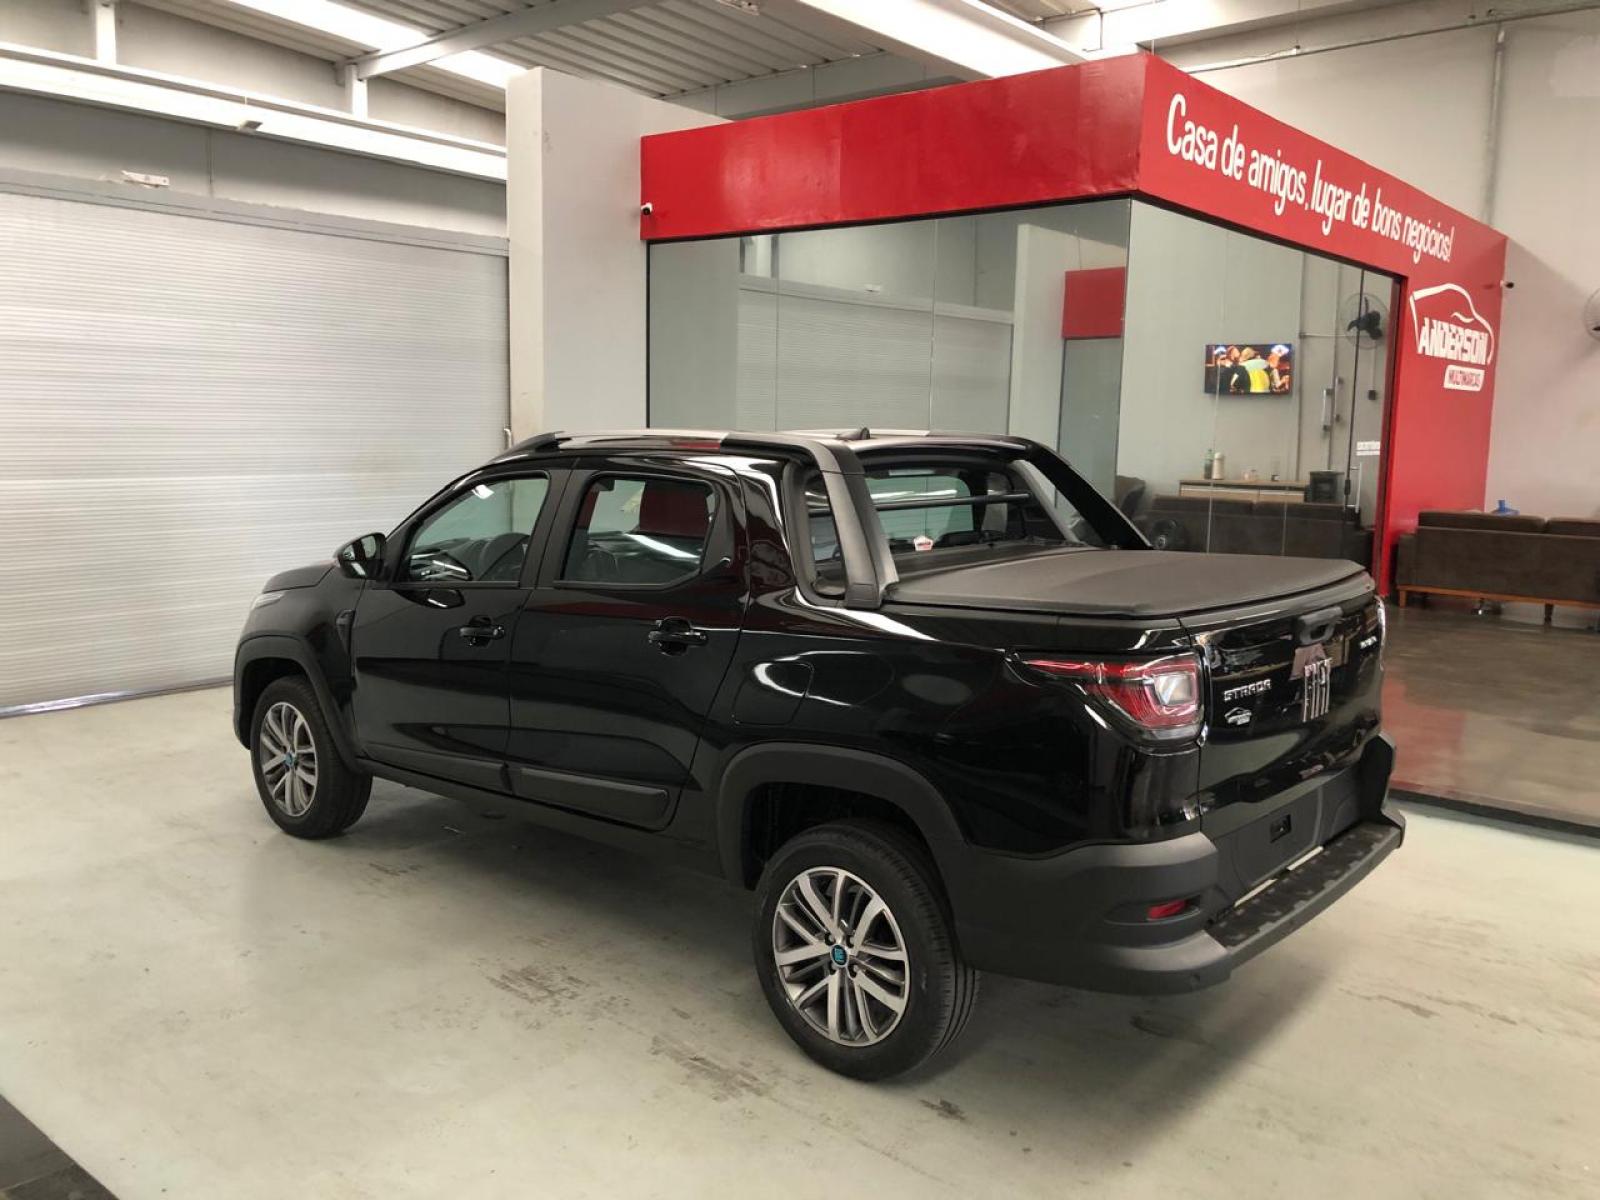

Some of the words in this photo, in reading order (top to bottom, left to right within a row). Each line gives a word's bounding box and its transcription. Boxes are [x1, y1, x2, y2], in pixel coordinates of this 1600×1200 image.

[1167, 93, 1218, 170] Casa
[1221, 124, 1245, 180] de
[1310, 159, 1351, 236] lugar
[1352, 182, 1370, 229] de
[1371, 187, 1402, 241] bons
[1418, 317, 1488, 365] ANDERSON
[1224, 679, 1271, 701] STRADA
